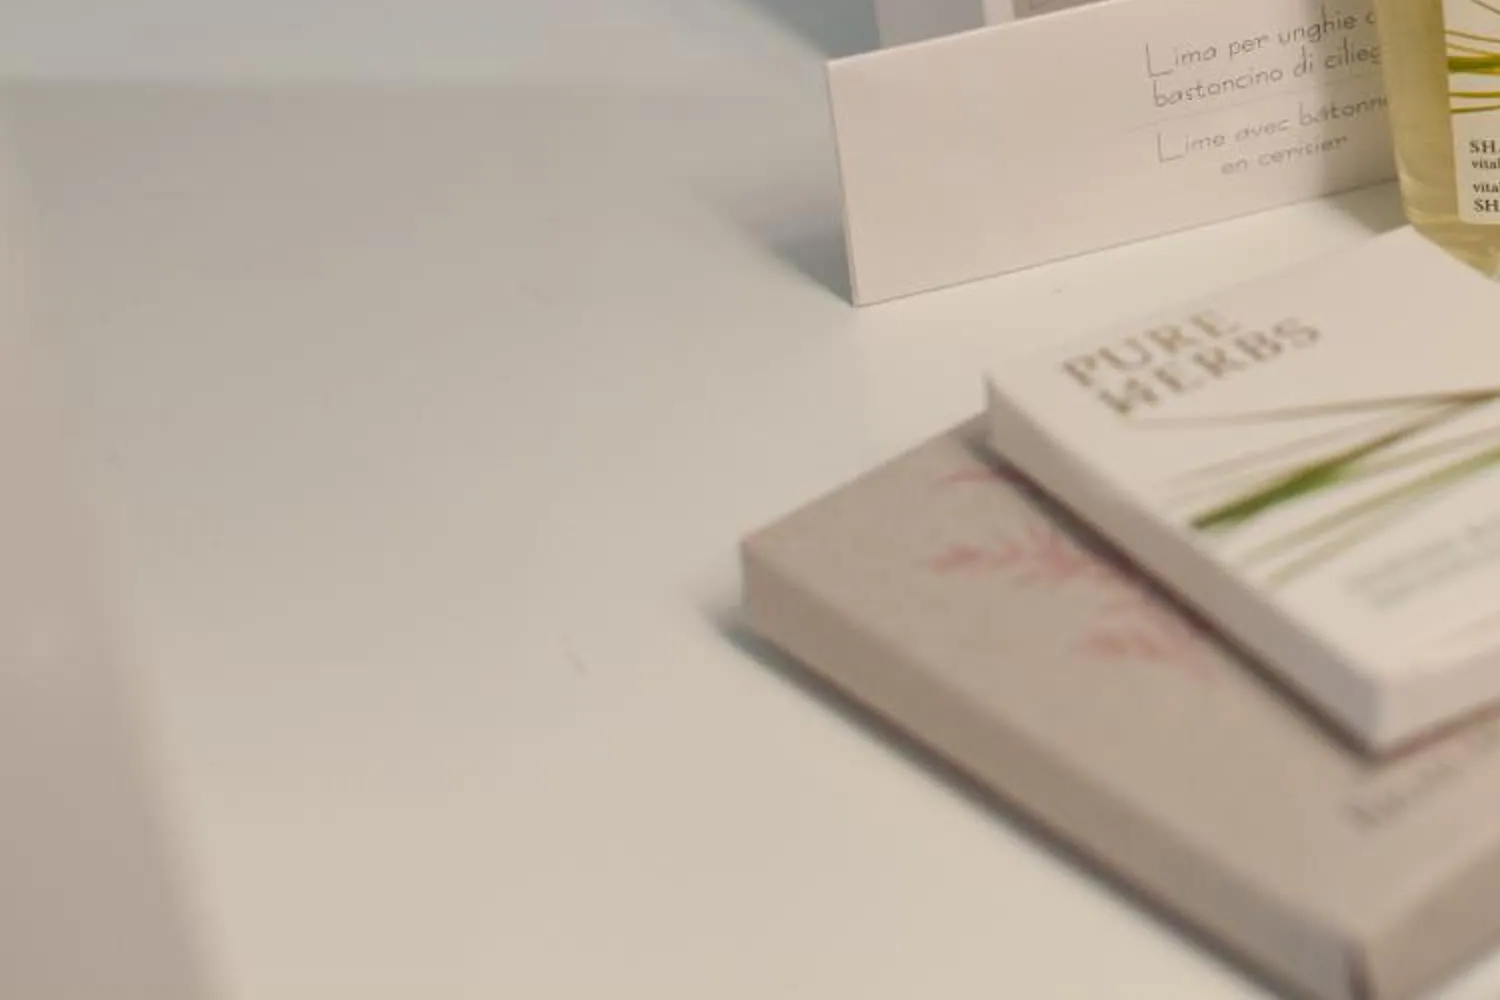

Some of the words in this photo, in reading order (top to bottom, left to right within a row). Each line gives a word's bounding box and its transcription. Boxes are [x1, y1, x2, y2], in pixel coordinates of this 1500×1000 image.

[1146, 43, 1218, 78] Lima
[1228, 34, 1270, 62] per
[1277, 3, 1358, 43] unghie
[1153, 66, 1284, 108] bastoncino
[1293, 46, 1314, 78] di
[1157, 132, 1225, 163] Lime
[1235, 119, 1290, 143] avec
[1221, 158, 1249, 176] en
[1062, 309, 1242, 388] PURE
[1099, 317, 1320, 415] HERBS
